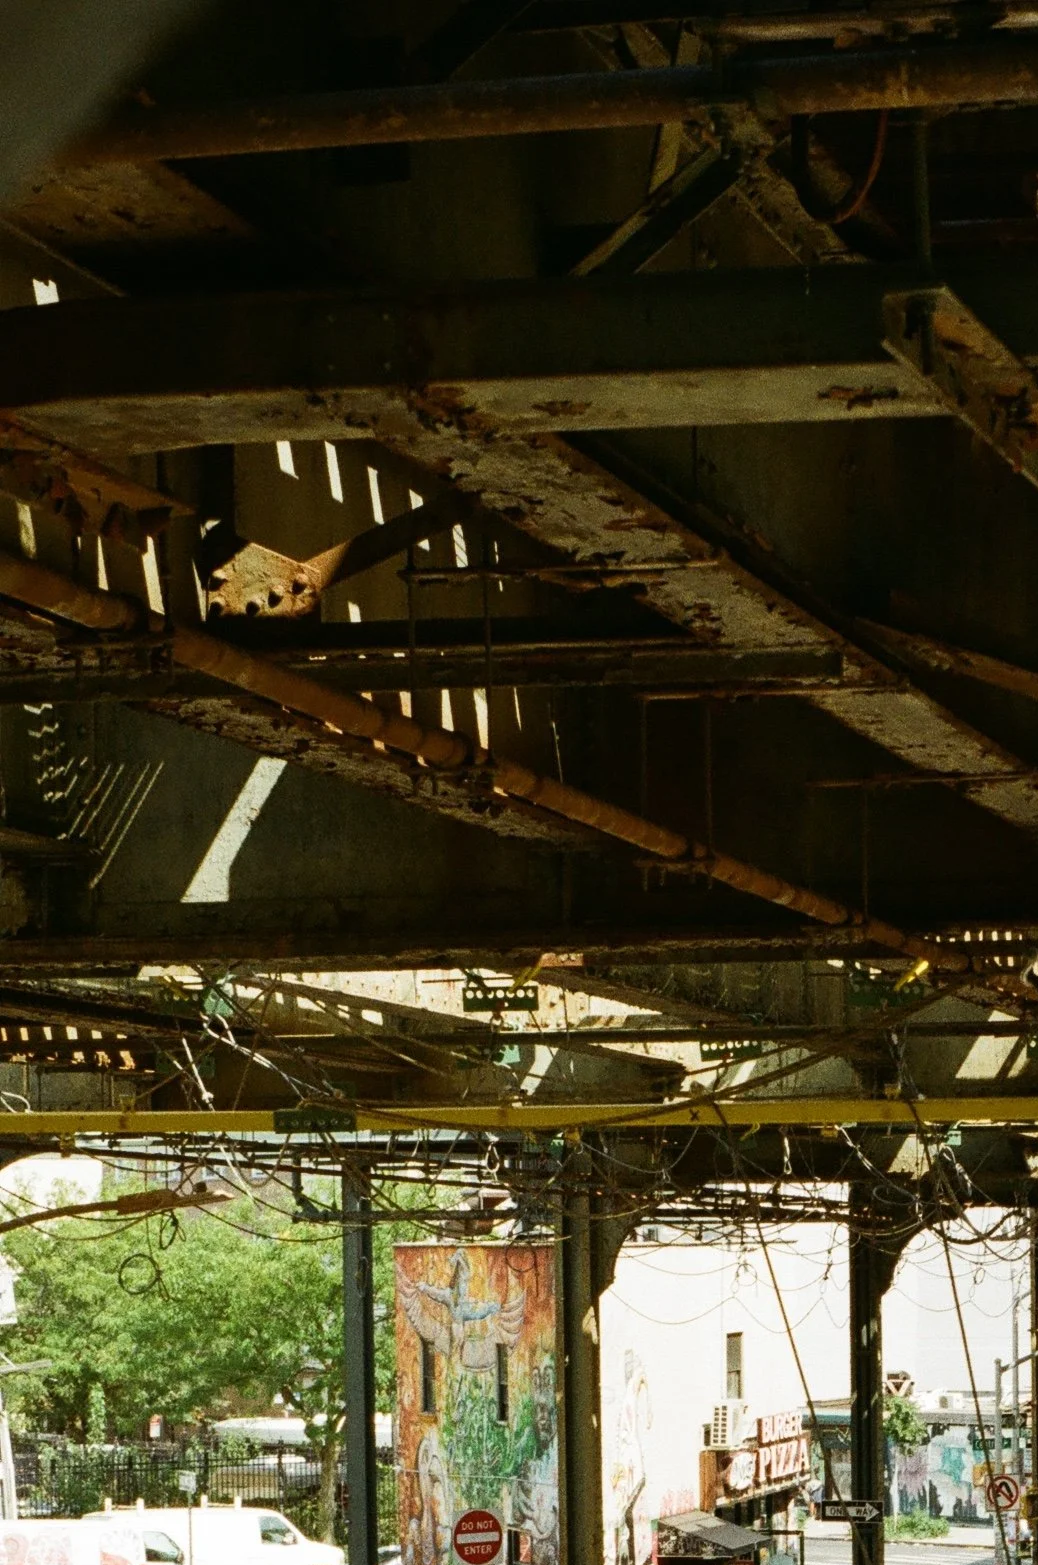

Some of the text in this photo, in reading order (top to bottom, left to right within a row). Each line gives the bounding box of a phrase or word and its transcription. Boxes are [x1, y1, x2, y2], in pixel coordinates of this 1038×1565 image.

[762, 1411, 803, 1443] BURGER
[758, 1438, 811, 1483] PIZZA
[855, 1507, 874, 1517] WAY
[461, 1520, 494, 1531] DO NOT
[464, 1544, 493, 1555] ENTER
